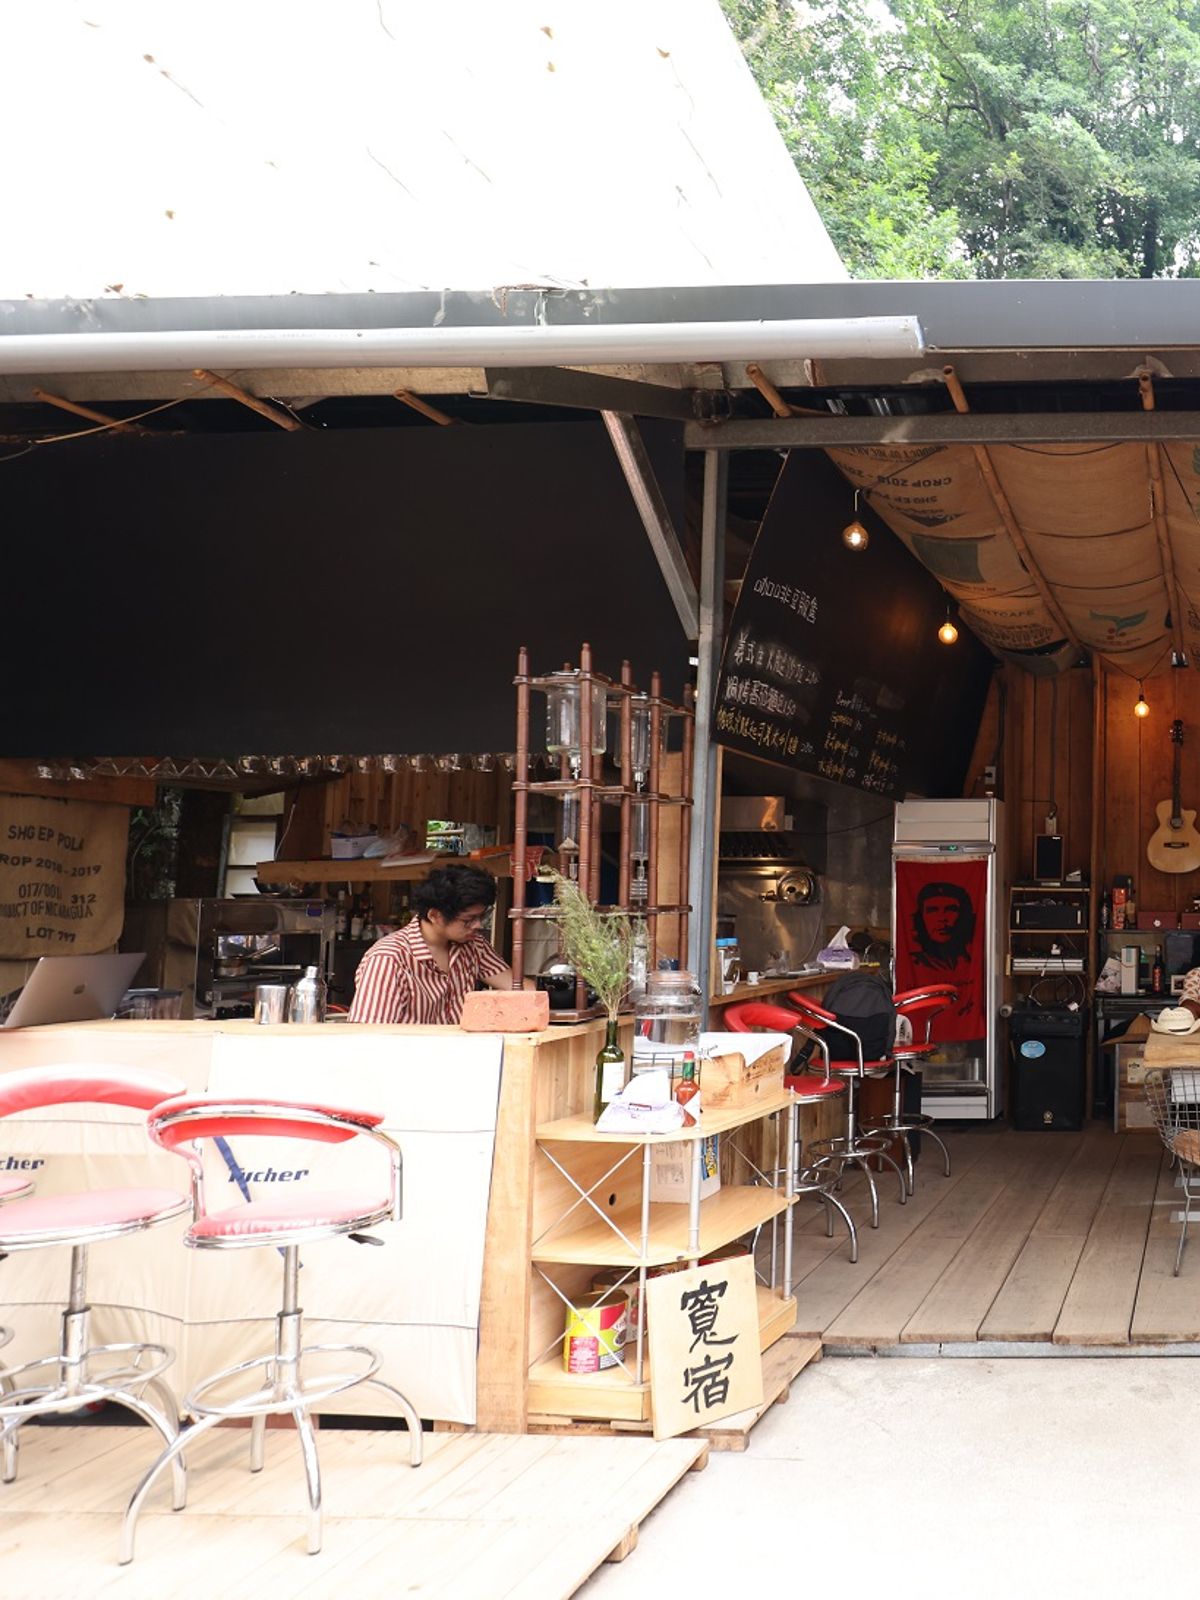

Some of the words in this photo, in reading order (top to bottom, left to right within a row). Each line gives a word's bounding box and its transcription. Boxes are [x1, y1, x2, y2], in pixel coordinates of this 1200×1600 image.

[8, 825, 36, 840] SHG
[38, 827, 54, 842] EP
[26, 927, 55, 940] LOT
